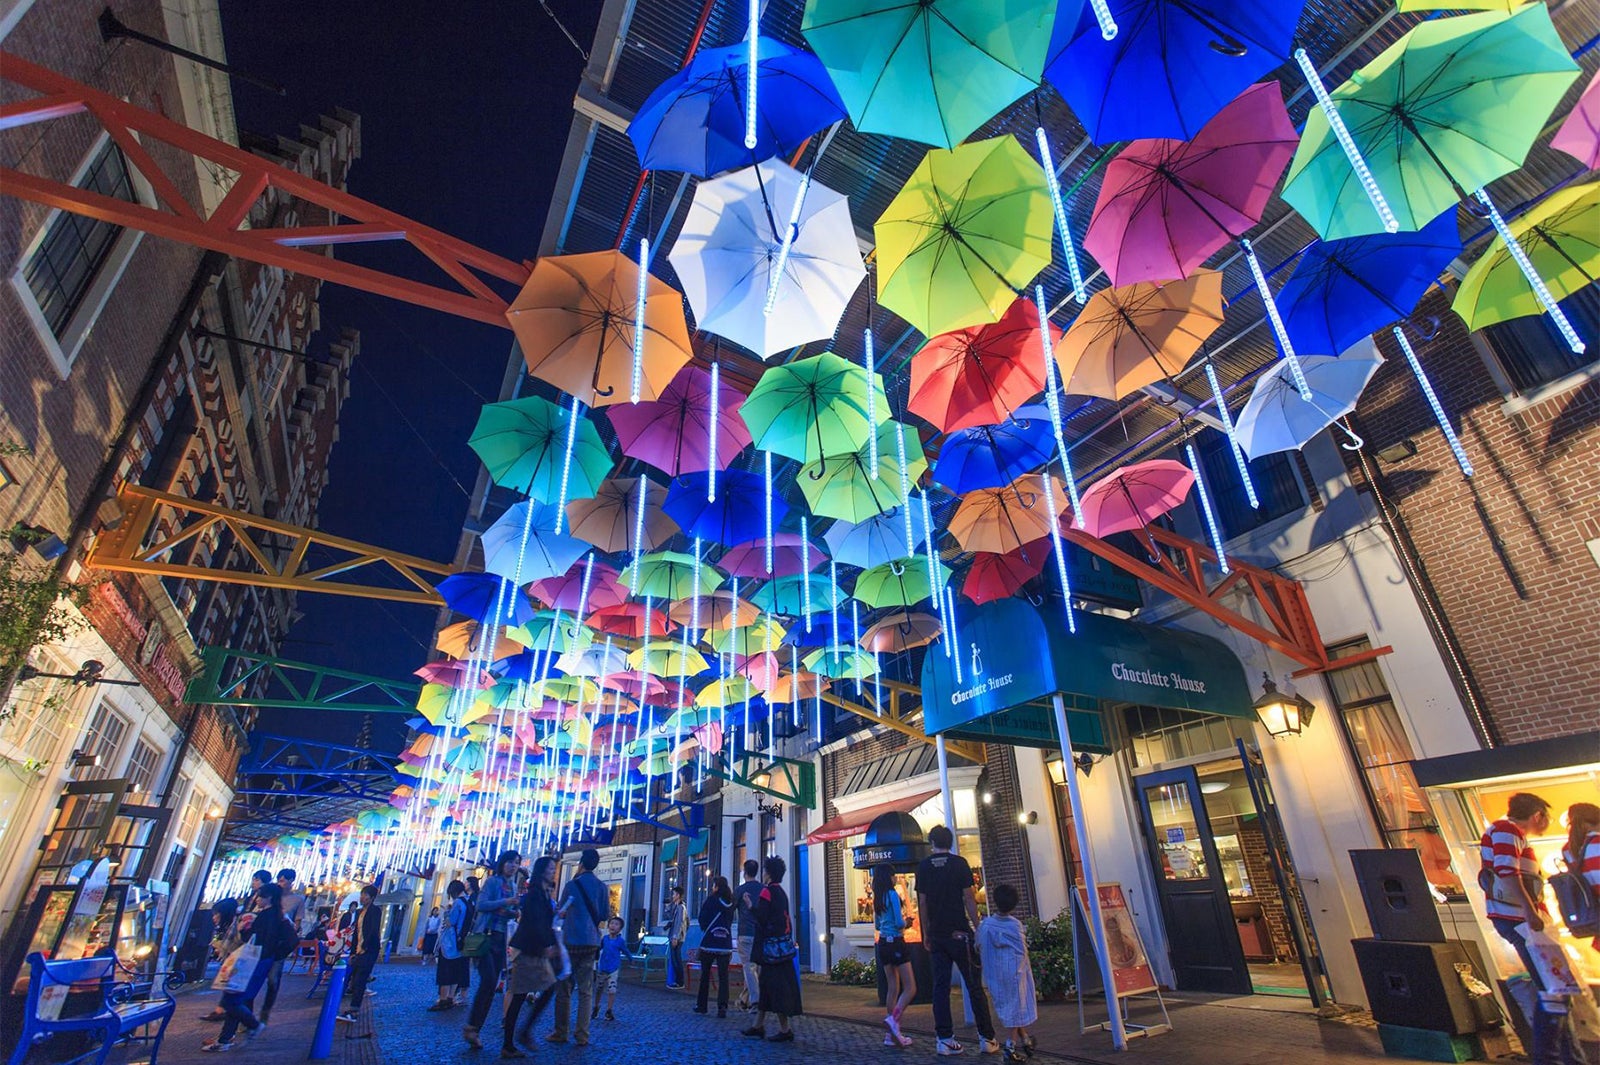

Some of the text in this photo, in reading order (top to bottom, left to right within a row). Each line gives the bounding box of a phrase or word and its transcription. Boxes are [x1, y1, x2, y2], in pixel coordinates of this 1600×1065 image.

[951, 673, 1013, 705] Chocolate House
[1111, 662, 1207, 694] Chocolate House
[868, 850, 892, 861] House
